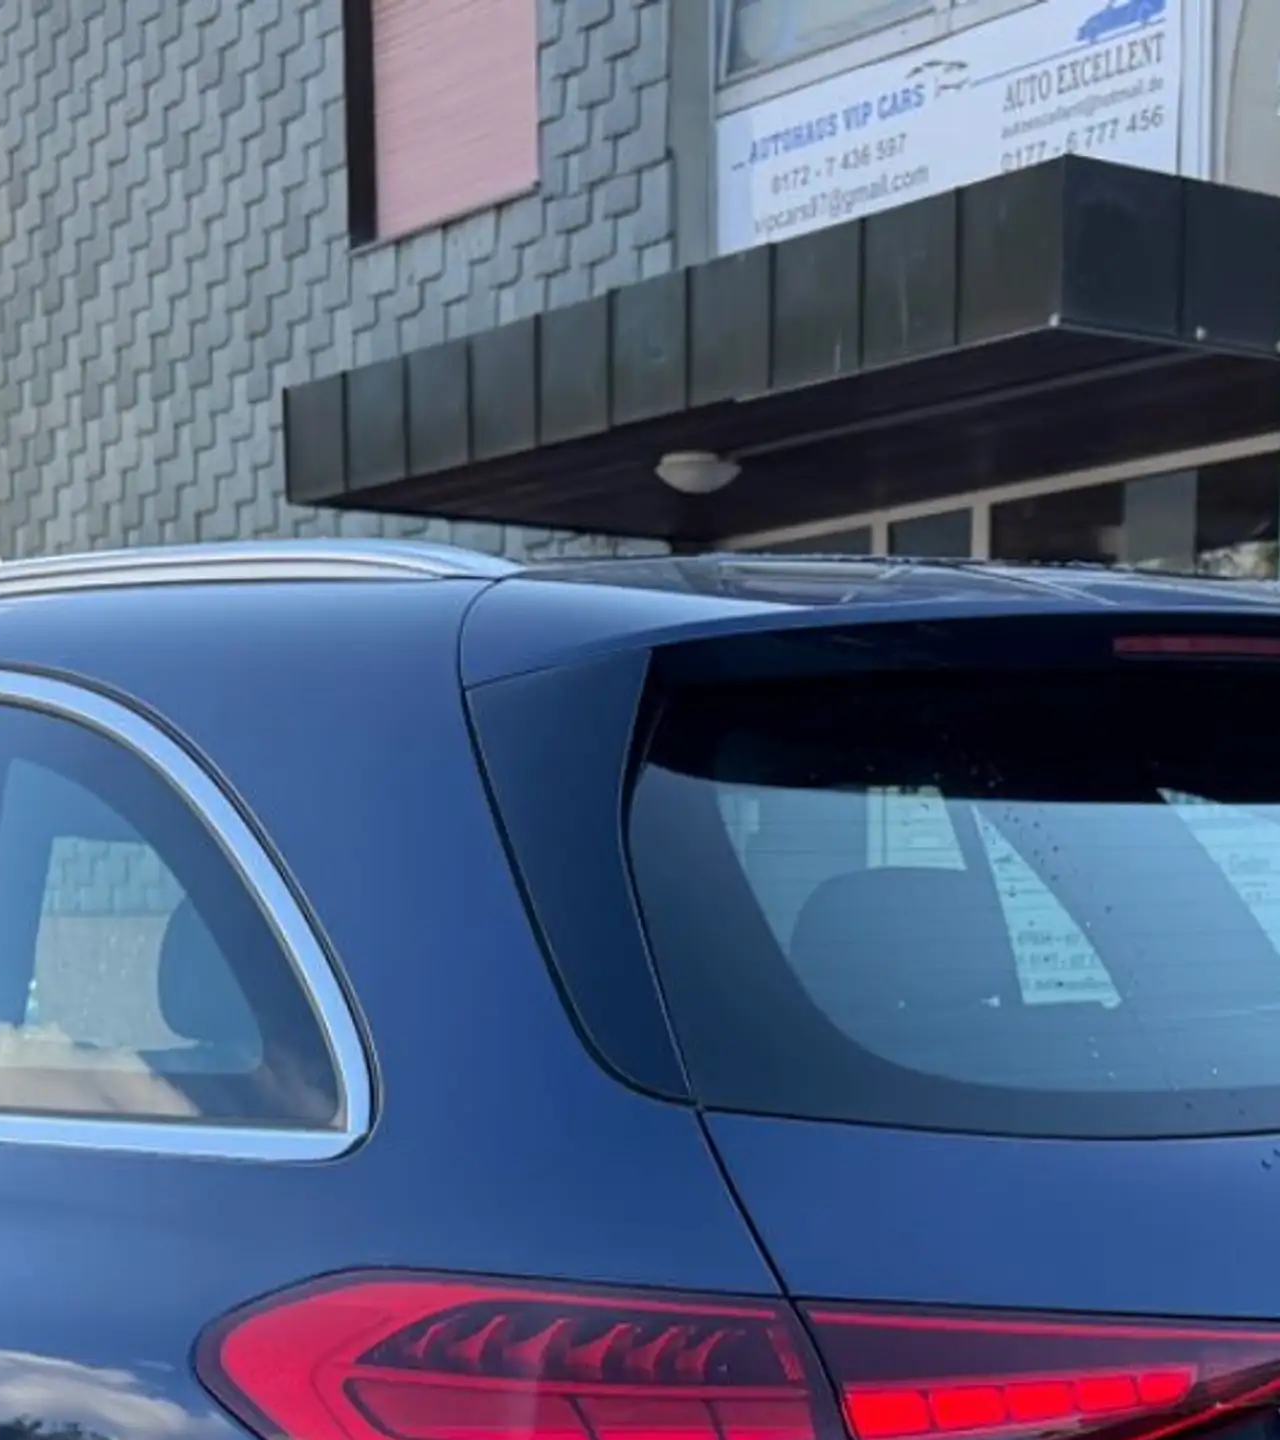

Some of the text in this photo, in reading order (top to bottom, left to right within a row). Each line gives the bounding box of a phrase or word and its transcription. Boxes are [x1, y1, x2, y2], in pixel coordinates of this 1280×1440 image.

[1003, 31, 1165, 113] AUTO EXCELLENT
[749, 84, 925, 164] AUTOHAUS VIP CARS
[1084, 117, 1119, 150] 777
[1126, 104, 1164, 133] 456
